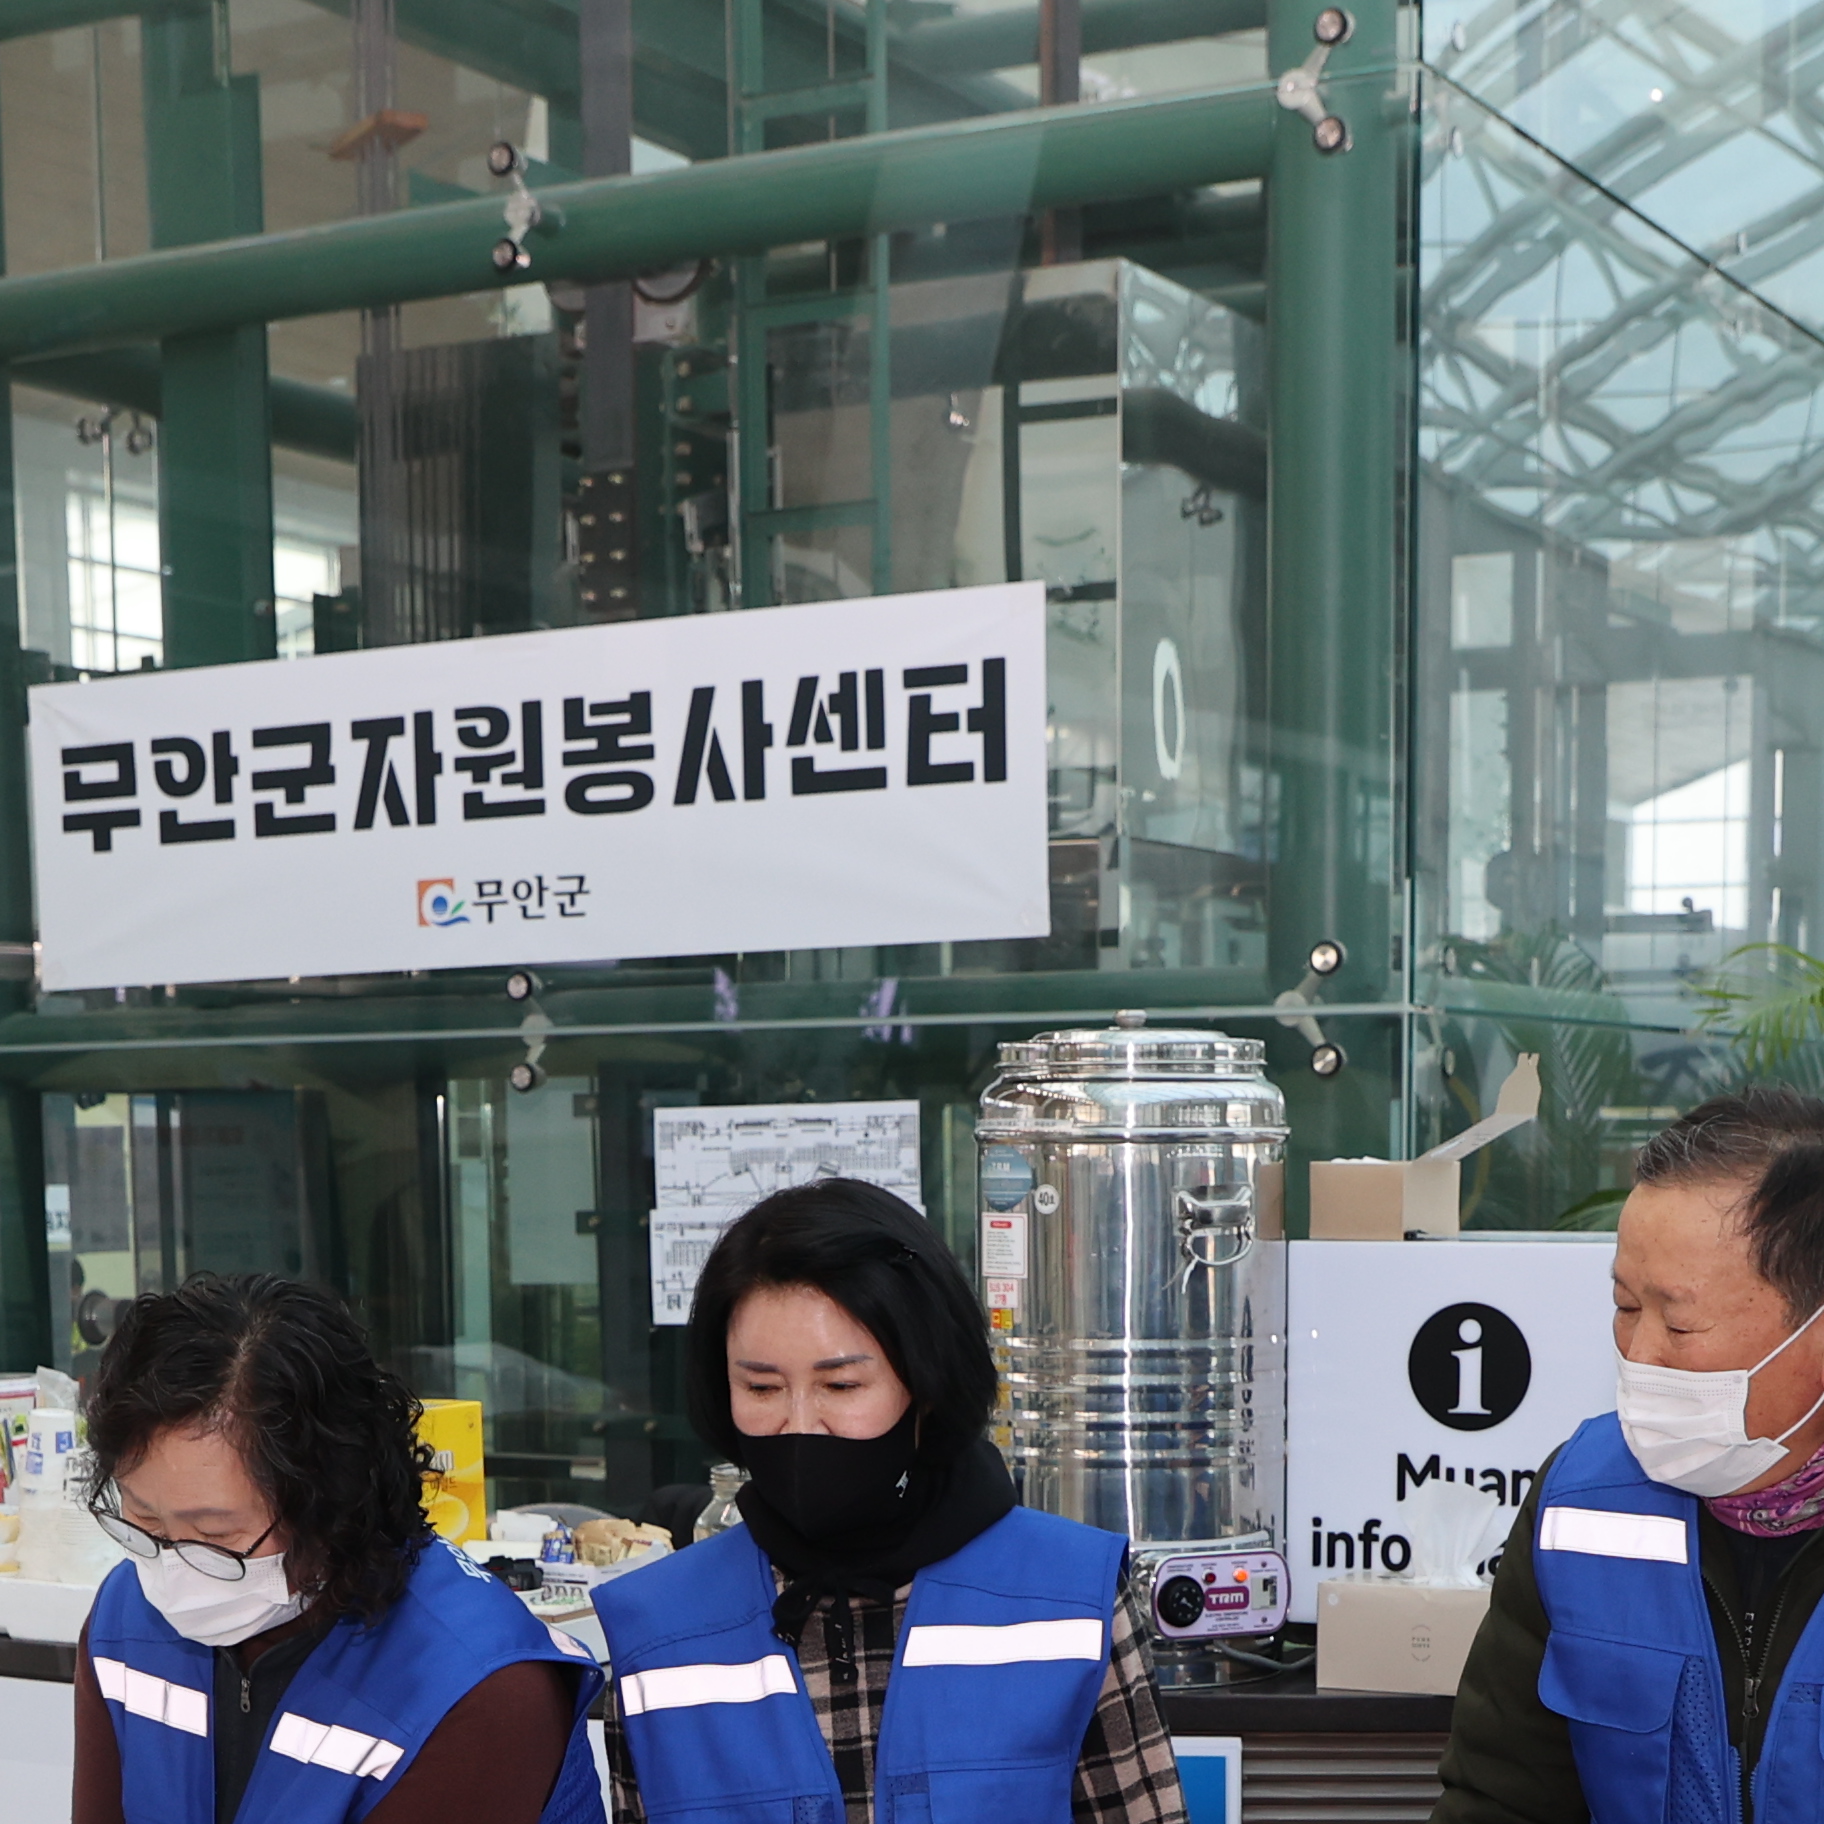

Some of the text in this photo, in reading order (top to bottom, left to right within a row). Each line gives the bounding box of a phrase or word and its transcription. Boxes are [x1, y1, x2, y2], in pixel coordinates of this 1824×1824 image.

[60, 655, 1010, 855] 무안군자원봉사센터
[472, 874, 591, 926] 무안군
[1209, 1592, 1245, 1605] TRM
